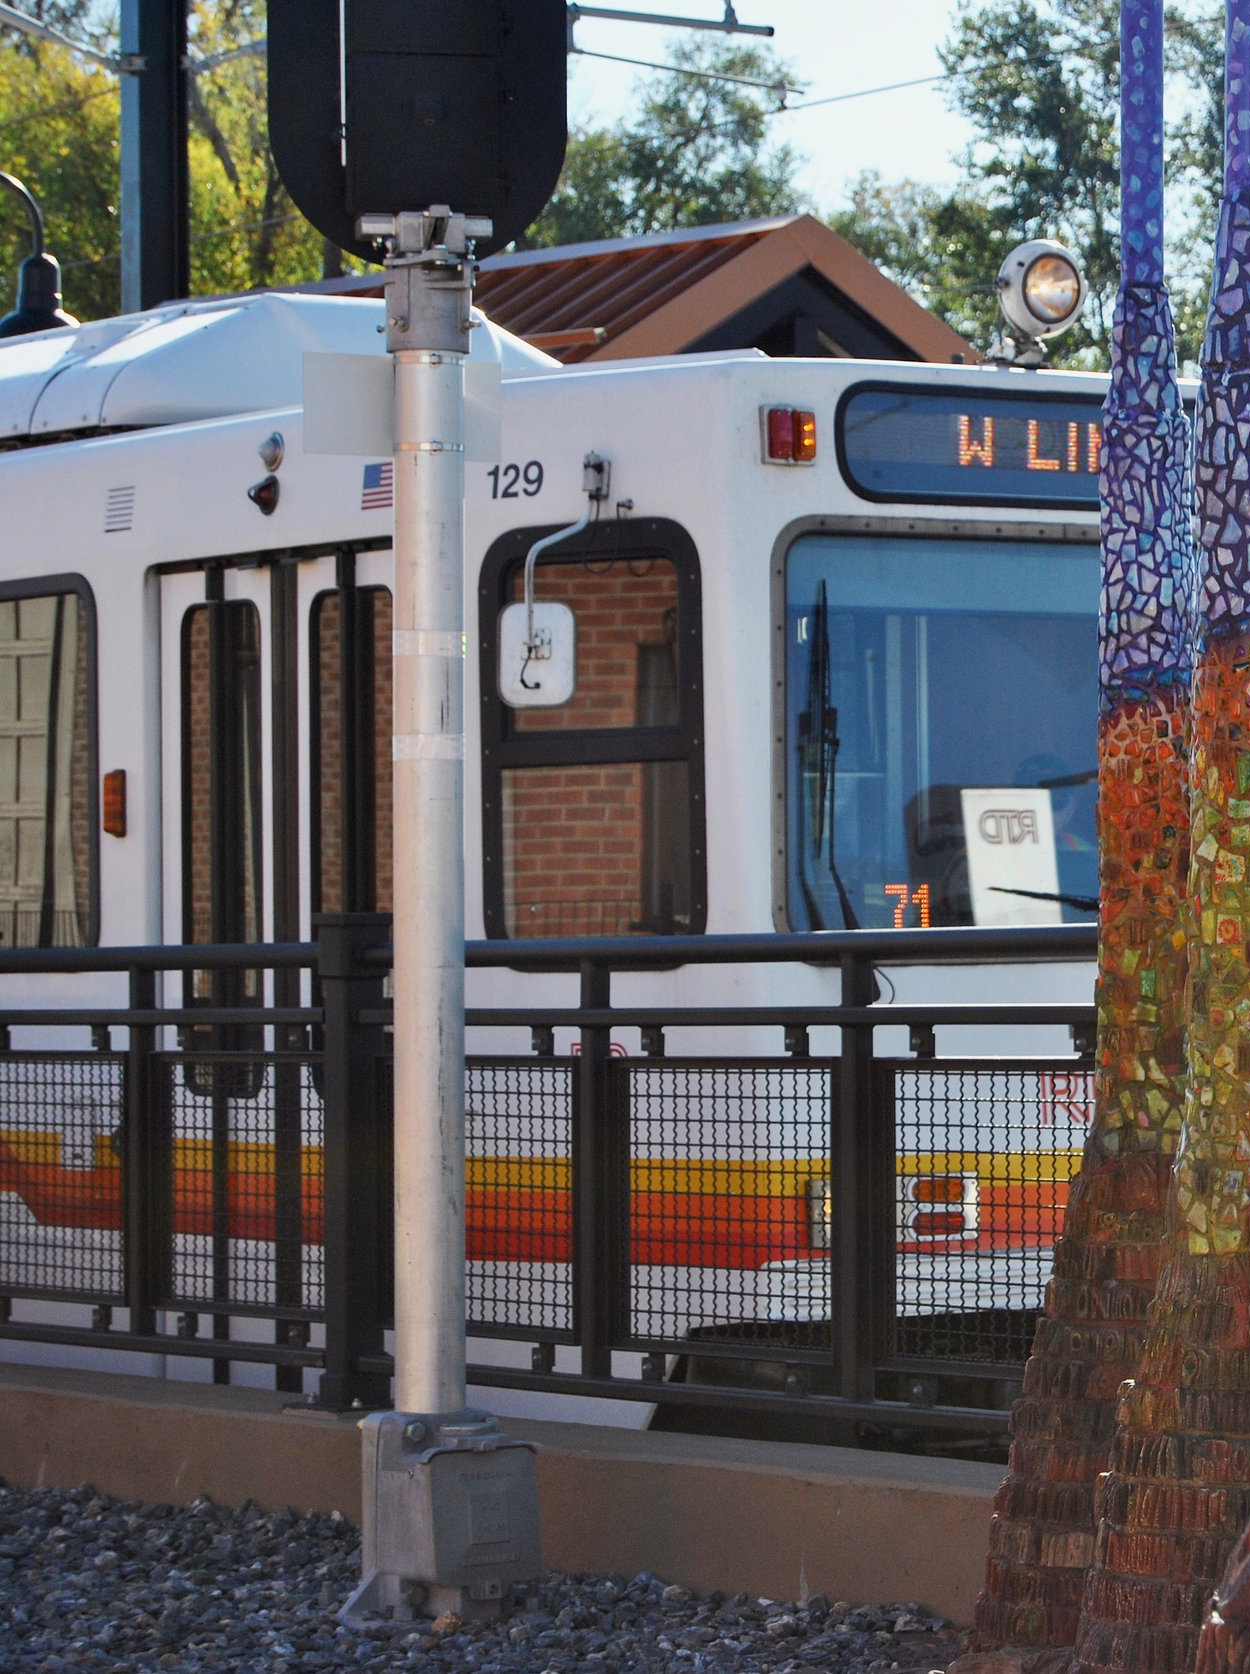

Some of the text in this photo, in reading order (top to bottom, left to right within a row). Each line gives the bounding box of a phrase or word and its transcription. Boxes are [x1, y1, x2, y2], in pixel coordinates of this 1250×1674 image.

[959, 414, 994, 467] W
[487, 460, 544, 499] 129
[885, 883, 930, 928] 71
